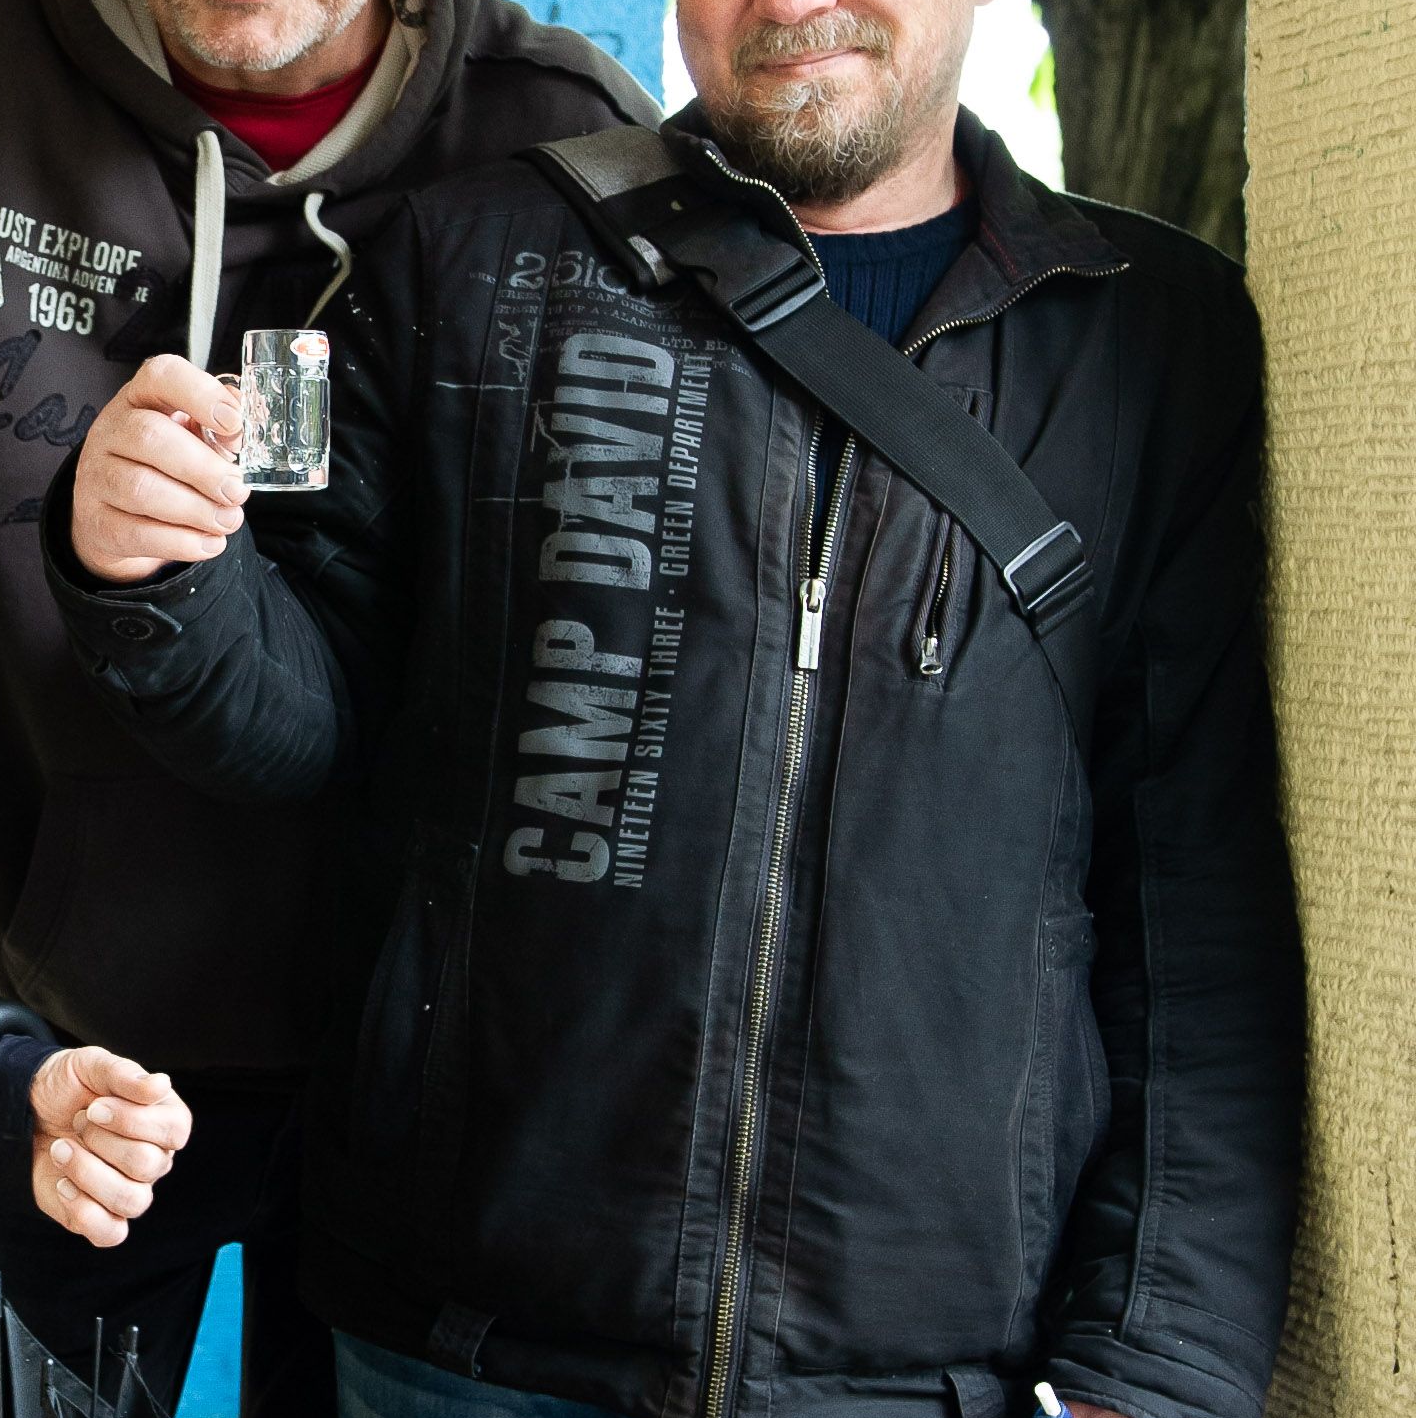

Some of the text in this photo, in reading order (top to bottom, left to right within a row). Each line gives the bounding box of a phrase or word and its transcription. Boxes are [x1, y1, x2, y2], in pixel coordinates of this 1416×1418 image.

[4, 245, 69, 283] ARGENTINA
[28, 282, 96, 336] 1963
[667, 352, 713, 490] DEPARTMENT
[659, 500, 695, 577] GREEN
[503, 333, 676, 884] CAMP DAVID
[649, 606, 686, 678] THREE
[634, 689, 671, 759] SIXTY
[613, 770, 659, 889] NINETEEN
